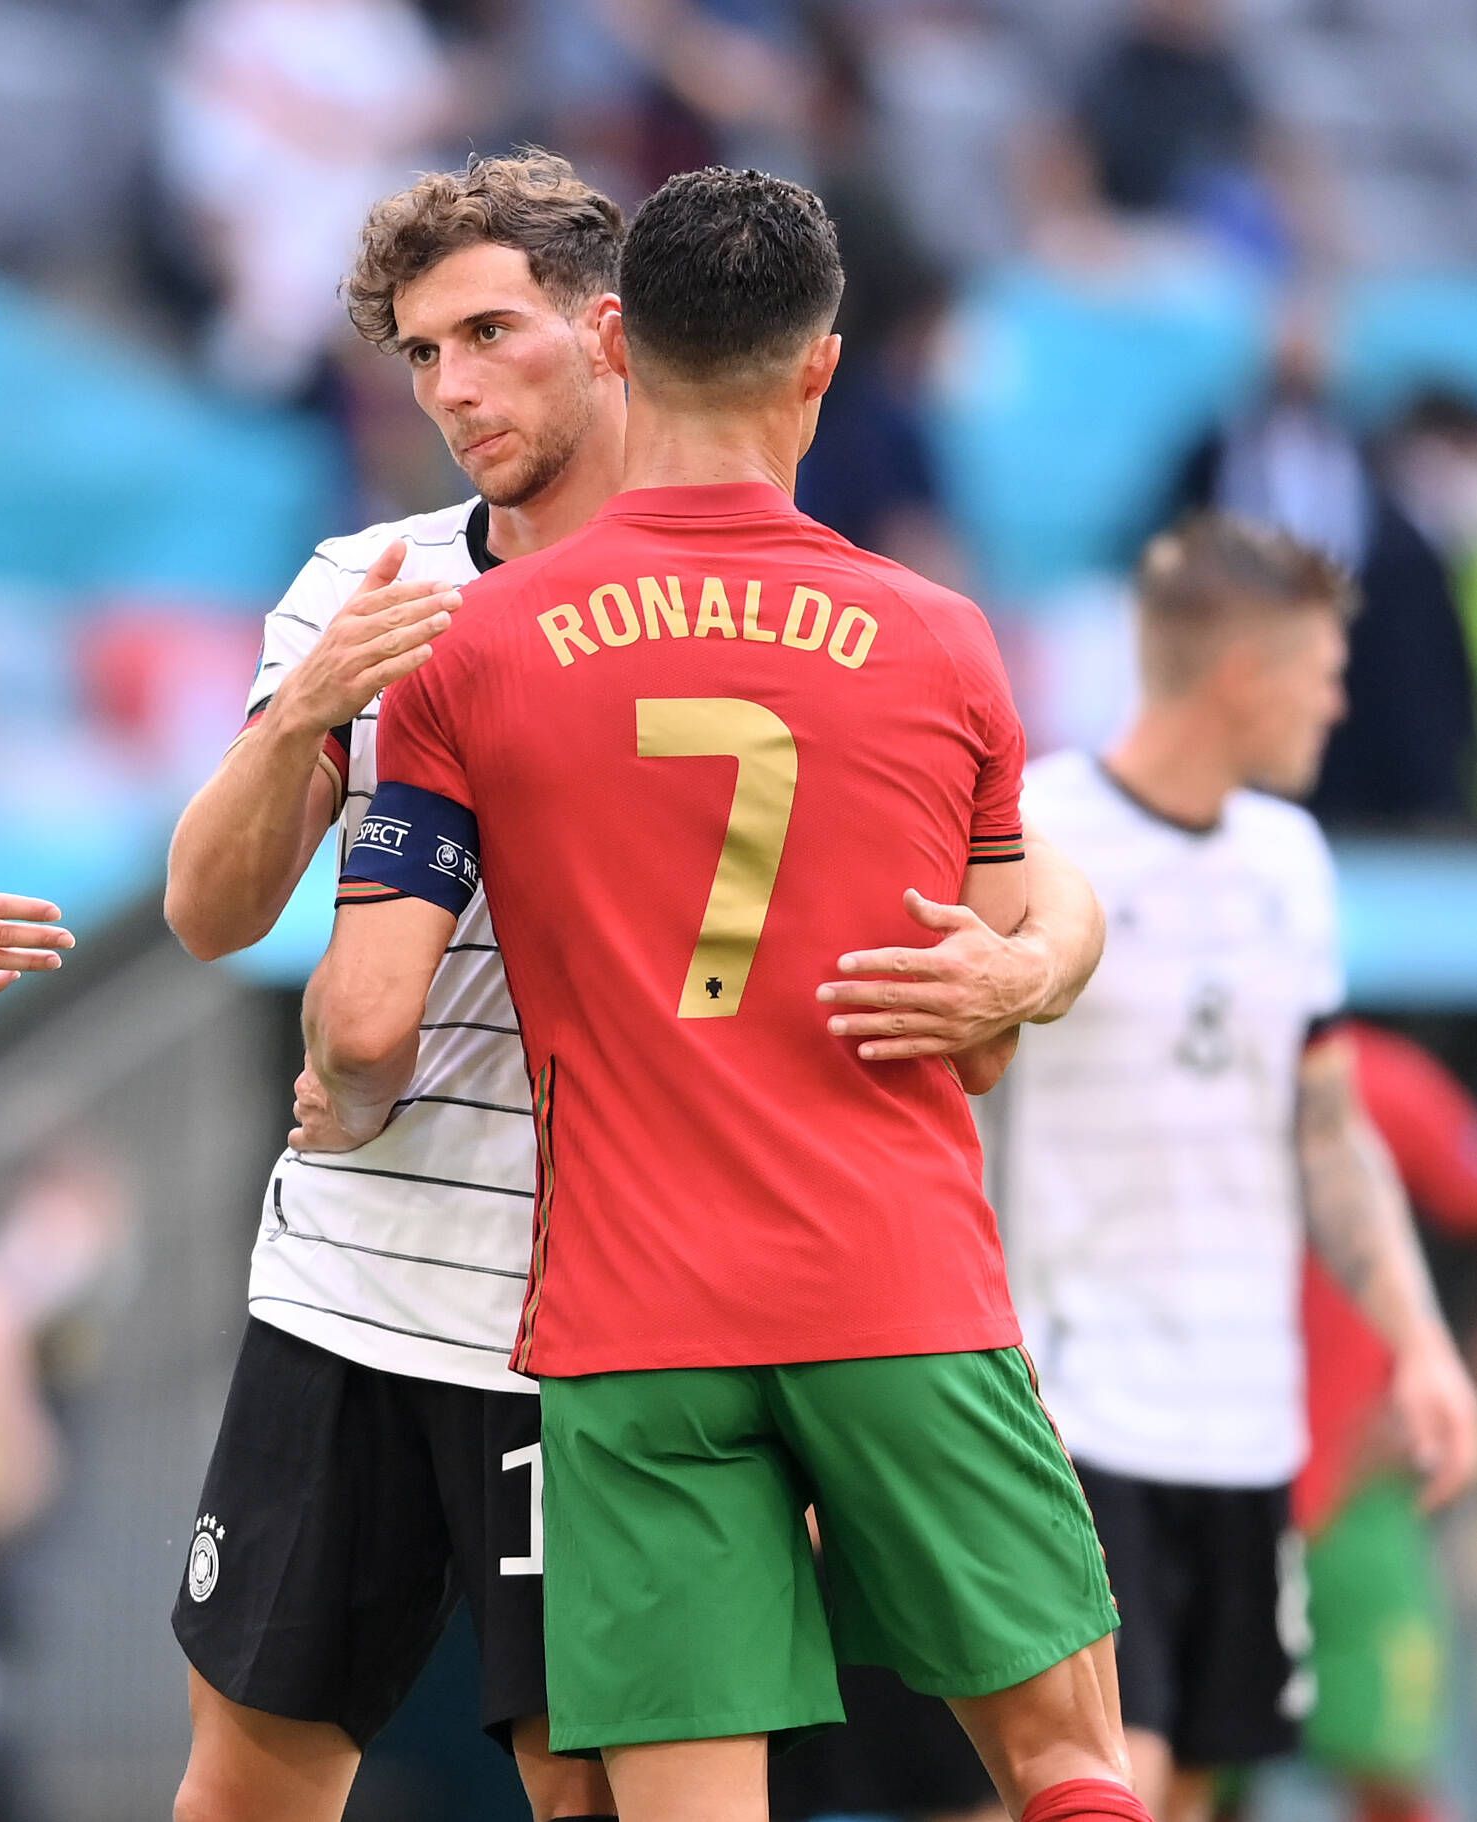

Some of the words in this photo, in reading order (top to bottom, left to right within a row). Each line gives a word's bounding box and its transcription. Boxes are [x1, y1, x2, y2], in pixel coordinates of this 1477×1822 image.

[537, 575, 878, 669] RONALDO
[354, 822, 409, 848] SPECT
[635, 697, 798, 1018] 7
